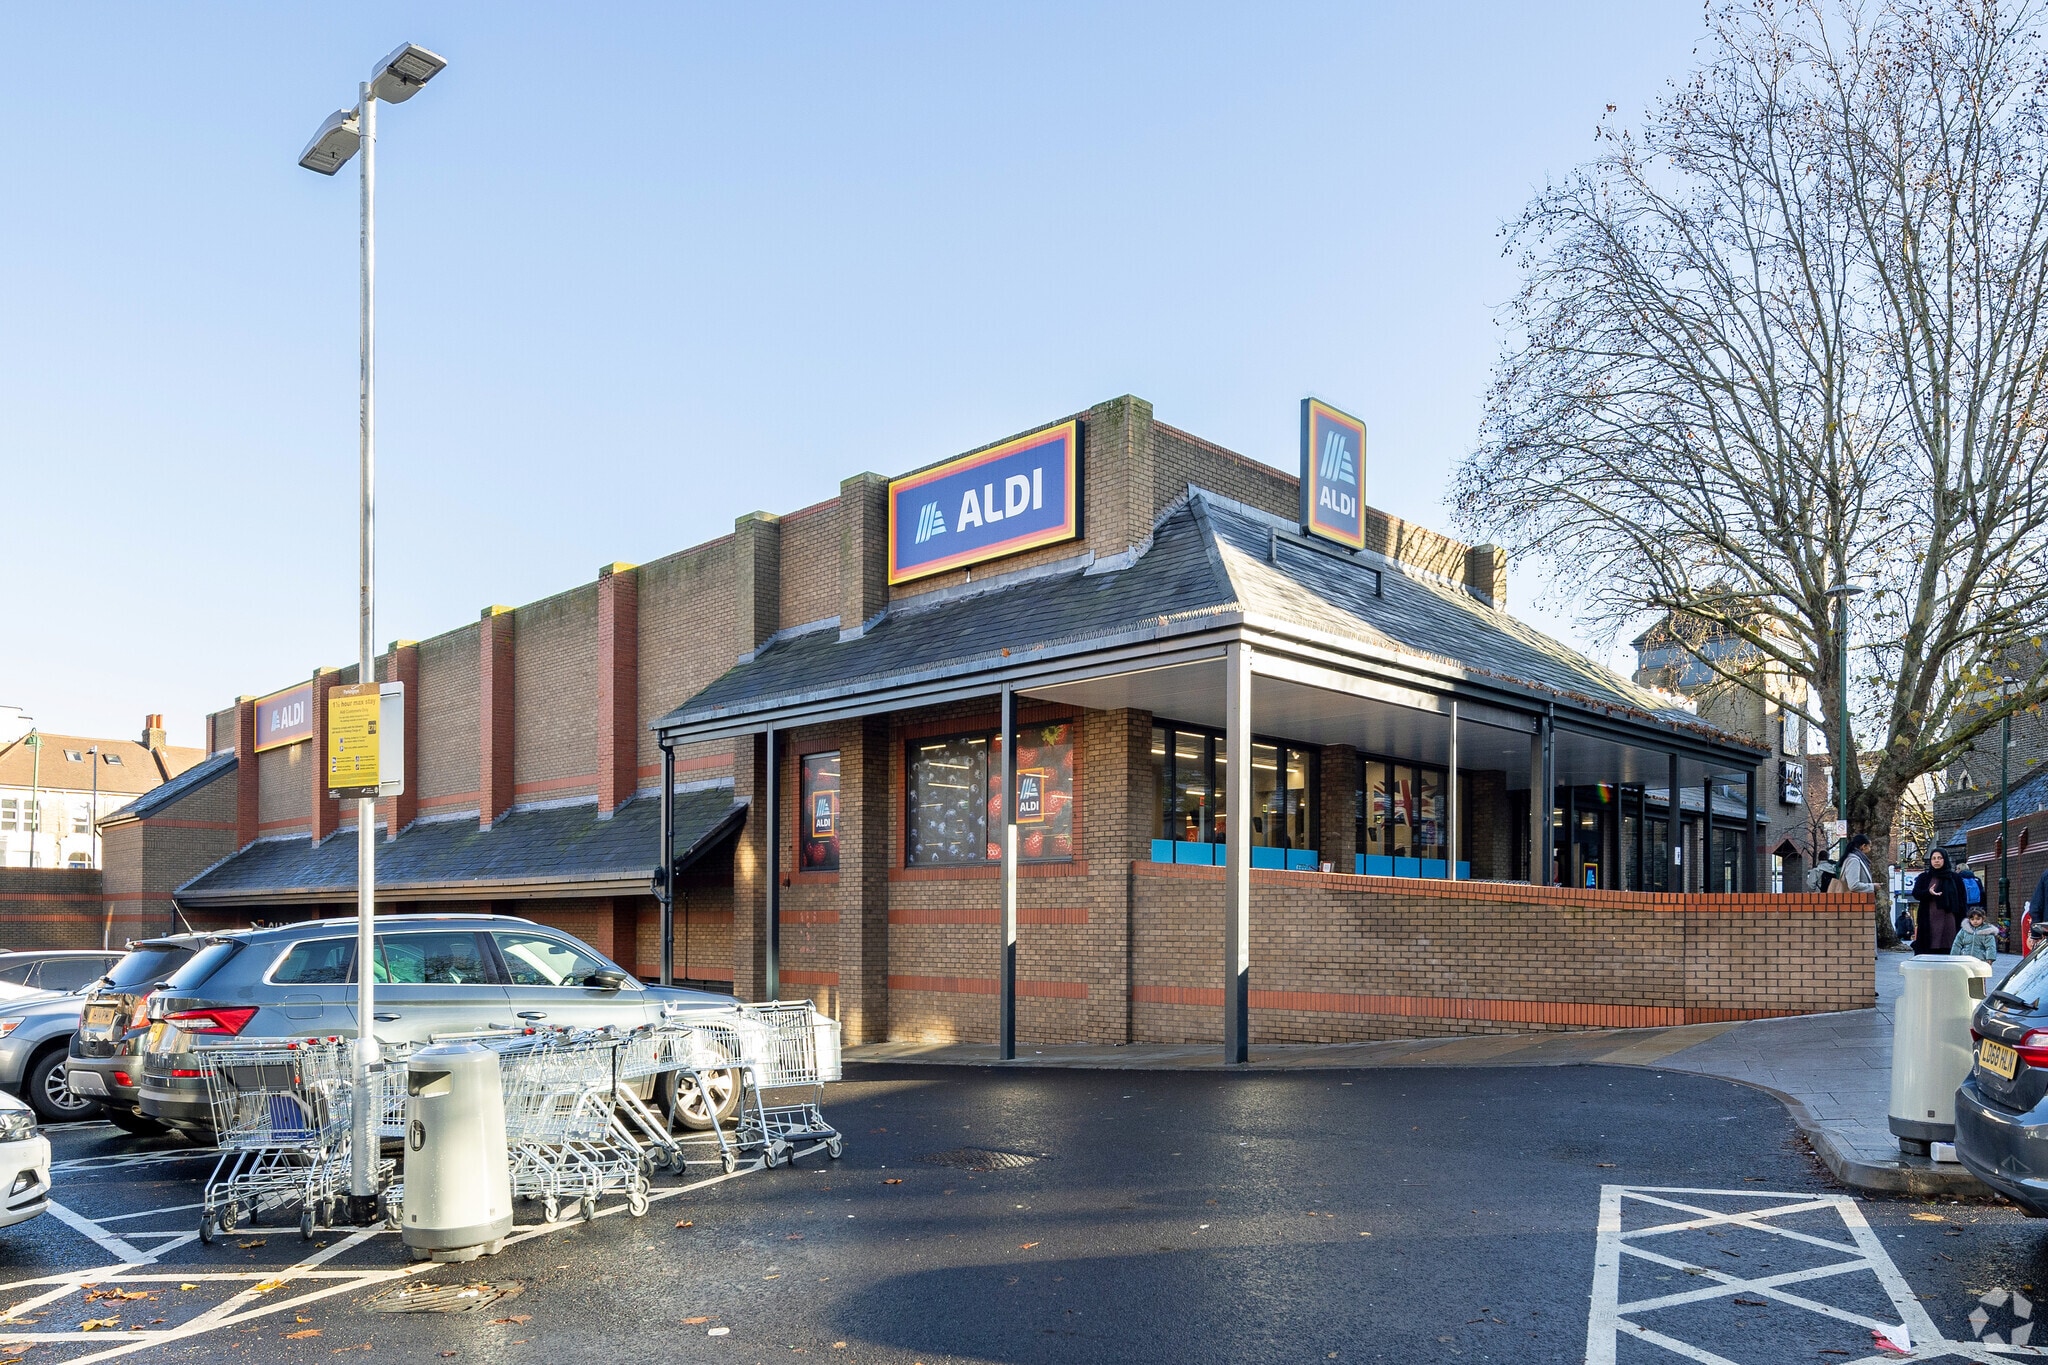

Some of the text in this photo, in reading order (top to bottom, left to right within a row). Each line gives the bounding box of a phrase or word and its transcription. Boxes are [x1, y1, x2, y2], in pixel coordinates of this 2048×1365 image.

[956, 467, 1043, 533] ALDI
[1319, 485, 1356, 518] ALDI
[281, 701, 304, 729] ALDI
[1020, 801, 1039, 812] ALDI
[816, 818, 831, 828] ALDI
